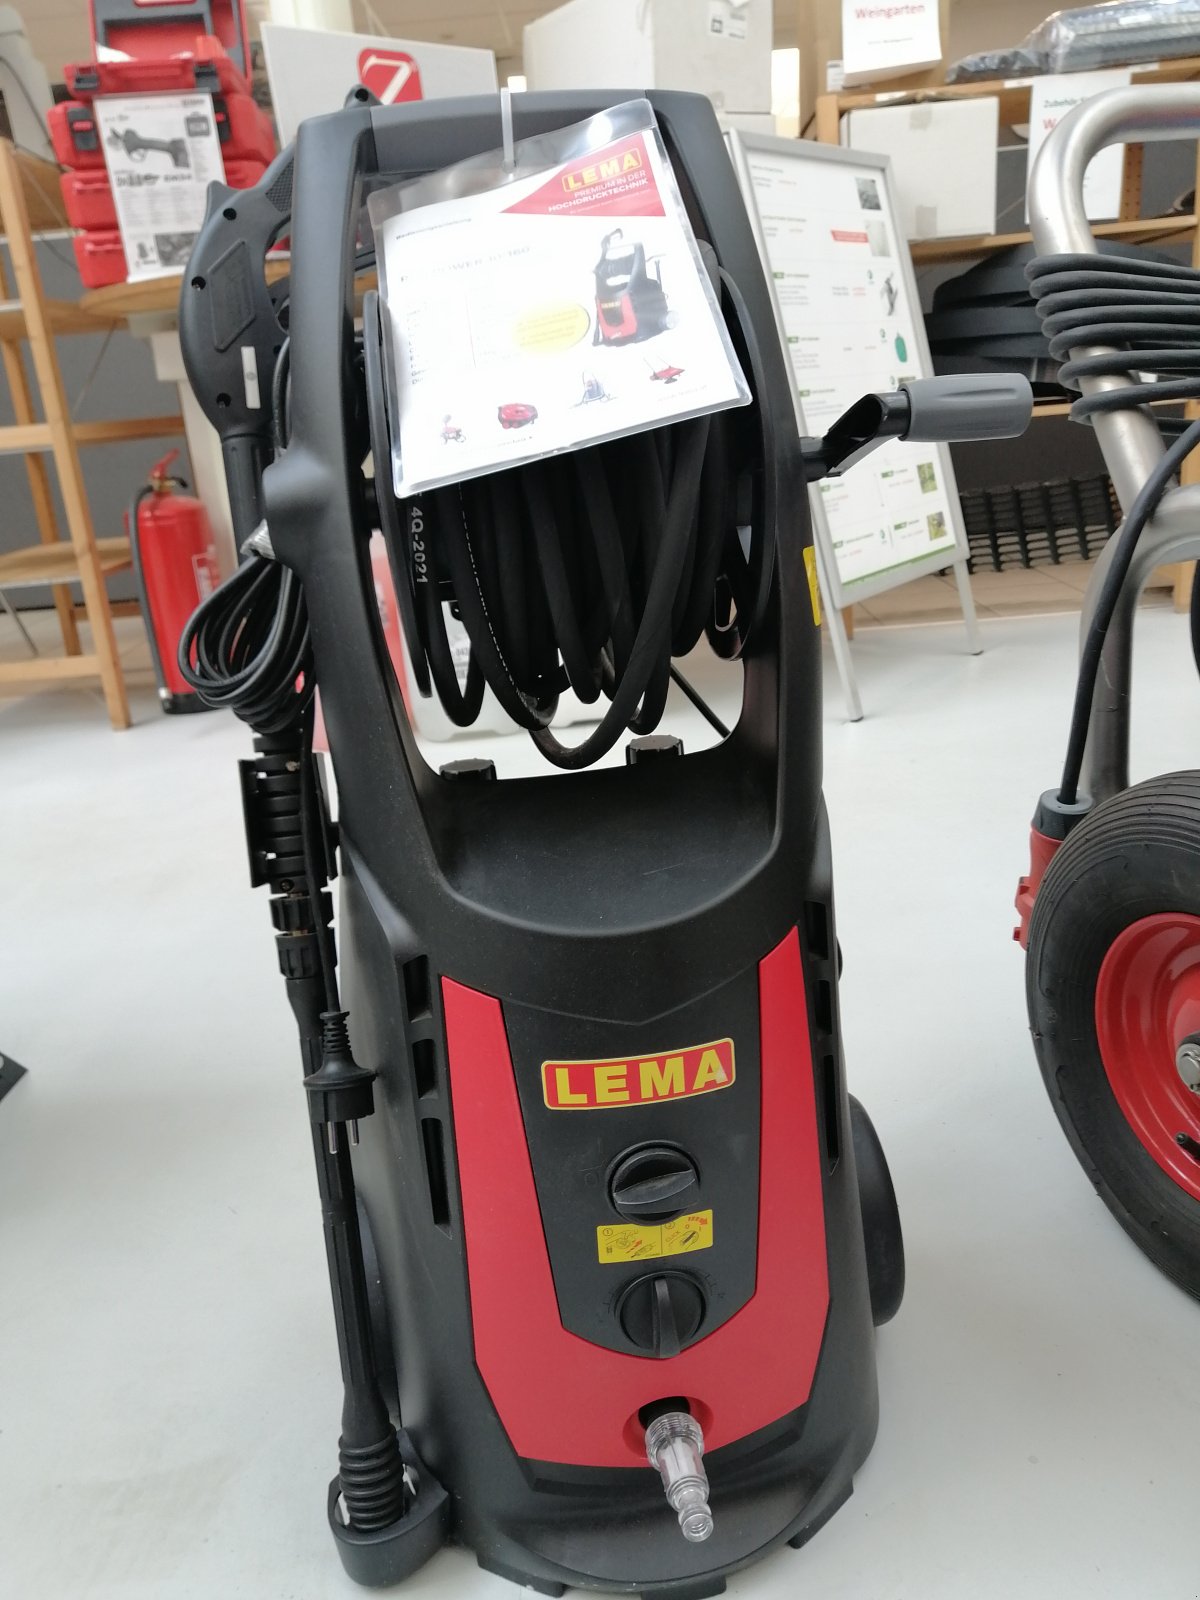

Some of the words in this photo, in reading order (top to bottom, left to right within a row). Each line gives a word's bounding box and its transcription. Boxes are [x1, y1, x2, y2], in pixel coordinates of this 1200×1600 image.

[567, 152, 639, 190] LEMA
[574, 180, 616, 198] PREMIUM
[627, 169, 647, 182] DER
[548, 177, 649, 213] HOCHDRUCKTECHNIK
[411, 506, 428, 583] 4Q-2021
[555, 1049, 728, 1105] LEMA
